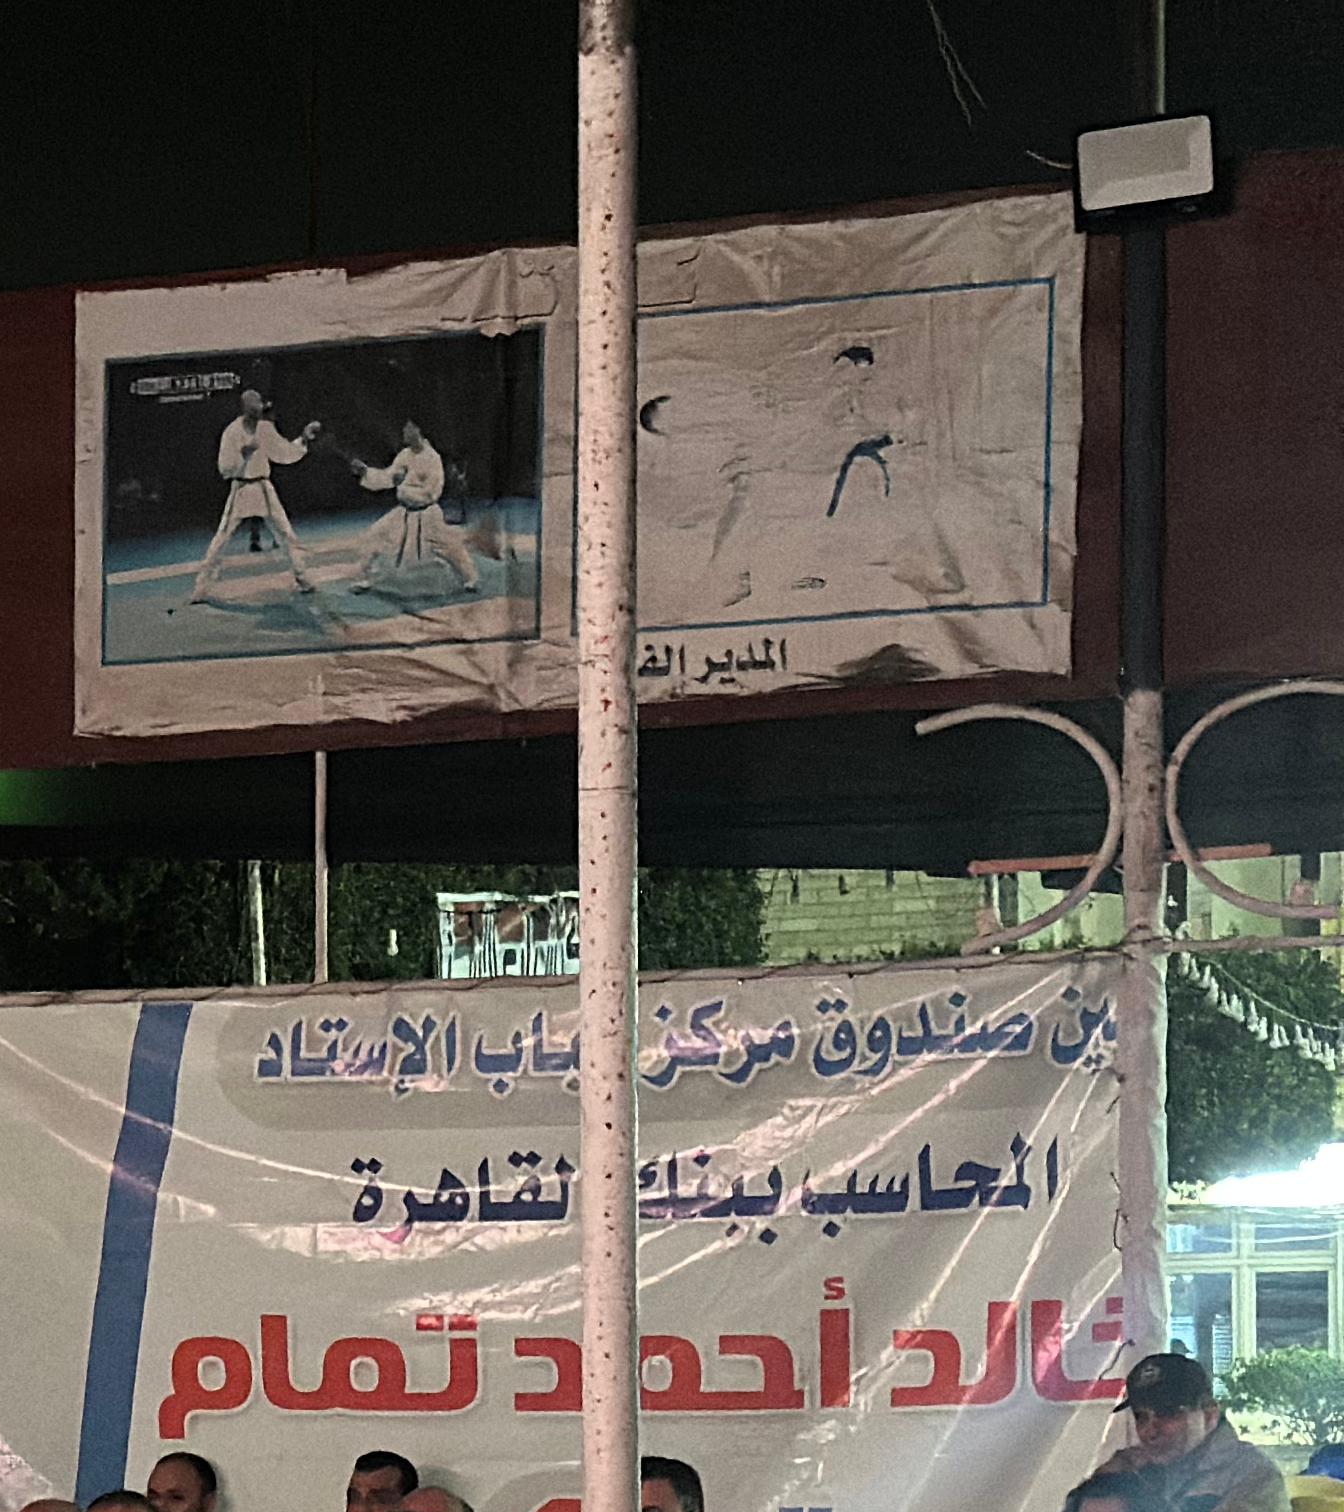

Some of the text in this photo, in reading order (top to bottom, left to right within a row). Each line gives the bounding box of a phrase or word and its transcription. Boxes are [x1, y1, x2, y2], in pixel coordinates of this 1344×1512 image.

[637, 637, 788, 684] المدير الف
[474, 1010, 581, 1095] باب
[641, 998, 796, 1088] مركز
[814, 991, 1033, 1077] صندوق
[351, 1148, 576, 1242] لقاهرة
[800, 1131, 1059, 1238] المحاسب
[158, 1313, 478, 1440] تمام
[513, 1275, 852, 1412] أحمد
